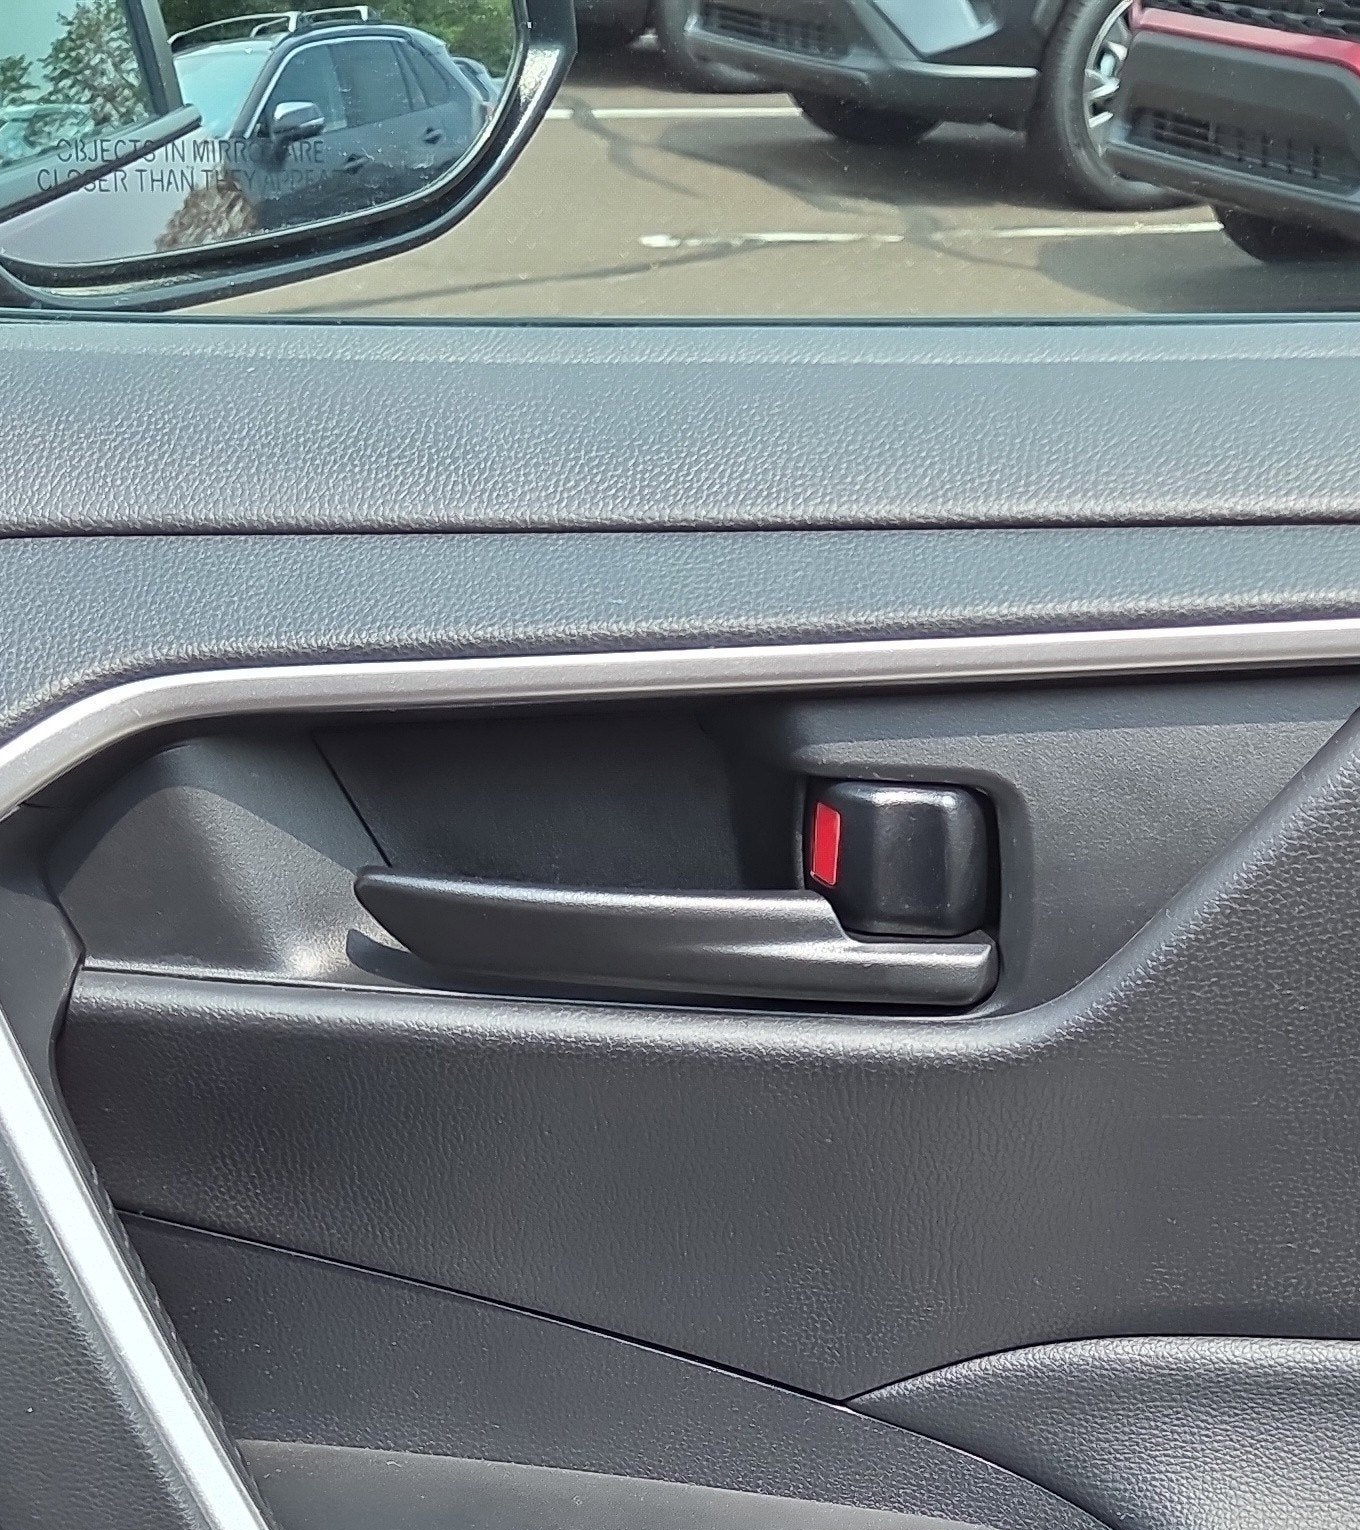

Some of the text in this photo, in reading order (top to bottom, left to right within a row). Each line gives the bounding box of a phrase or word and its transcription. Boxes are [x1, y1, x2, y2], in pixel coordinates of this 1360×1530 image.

[56, 138, 325, 163] OBJECTS IN MIRRO ARE
[135, 168, 195, 192] THAN
[263, 169, 344, 192] APPEA
